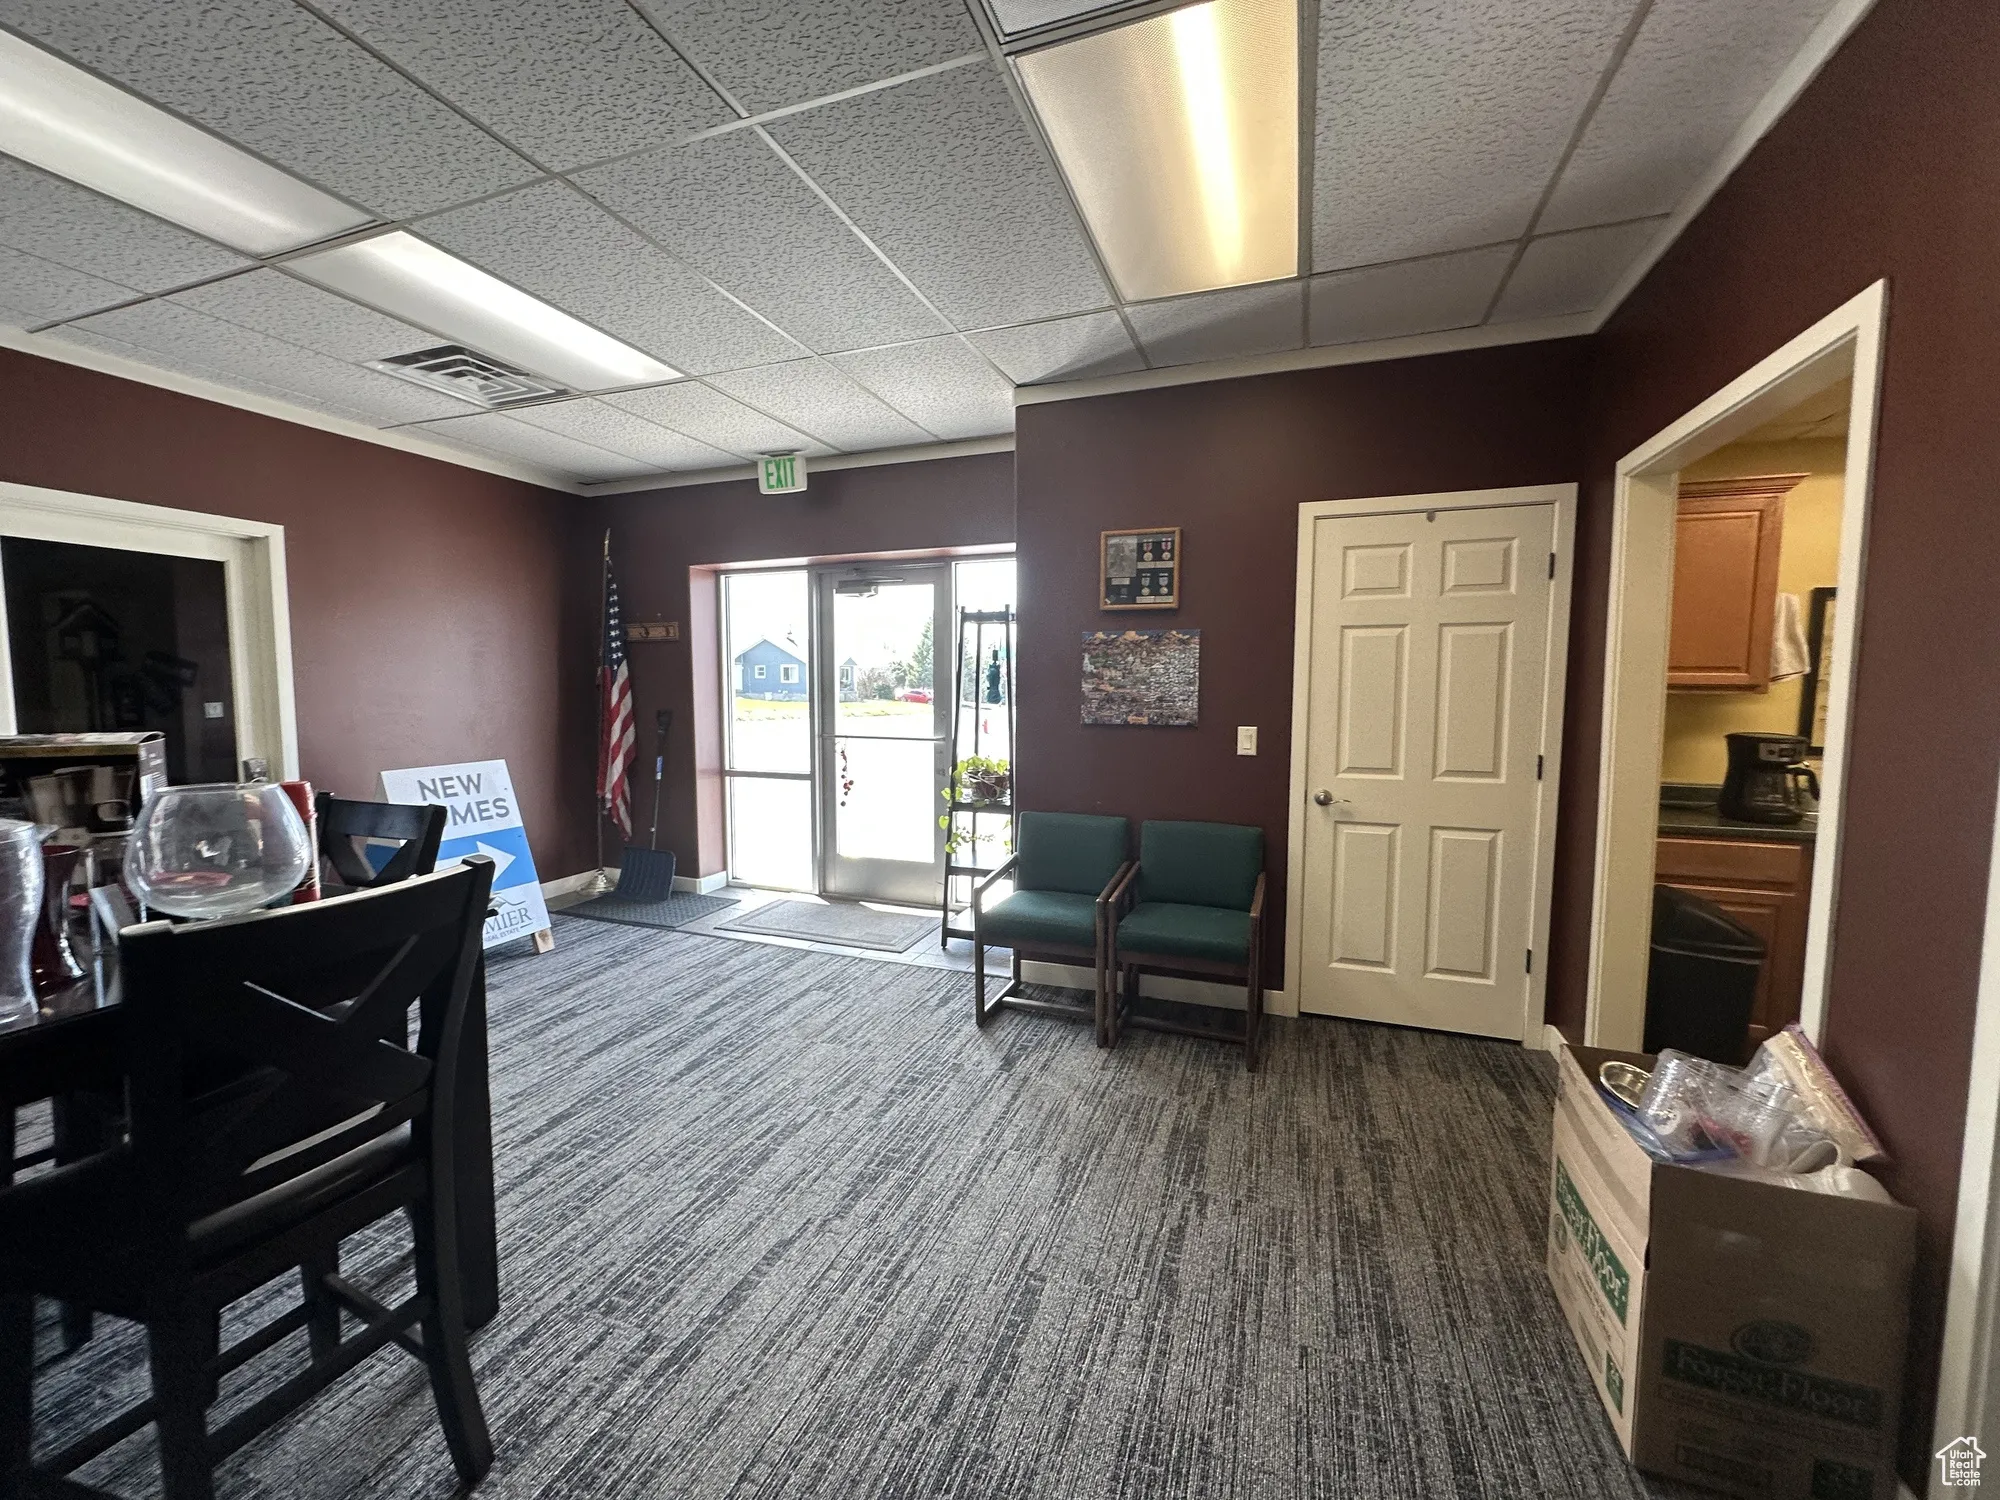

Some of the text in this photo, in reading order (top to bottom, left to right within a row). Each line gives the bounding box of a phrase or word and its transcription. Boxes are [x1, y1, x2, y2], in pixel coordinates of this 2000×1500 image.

[765, 457, 795, 489] EXIT
[417, 773, 482, 801] NEW
[446, 798, 510, 826] MES
[485, 907, 533, 934] MIER
